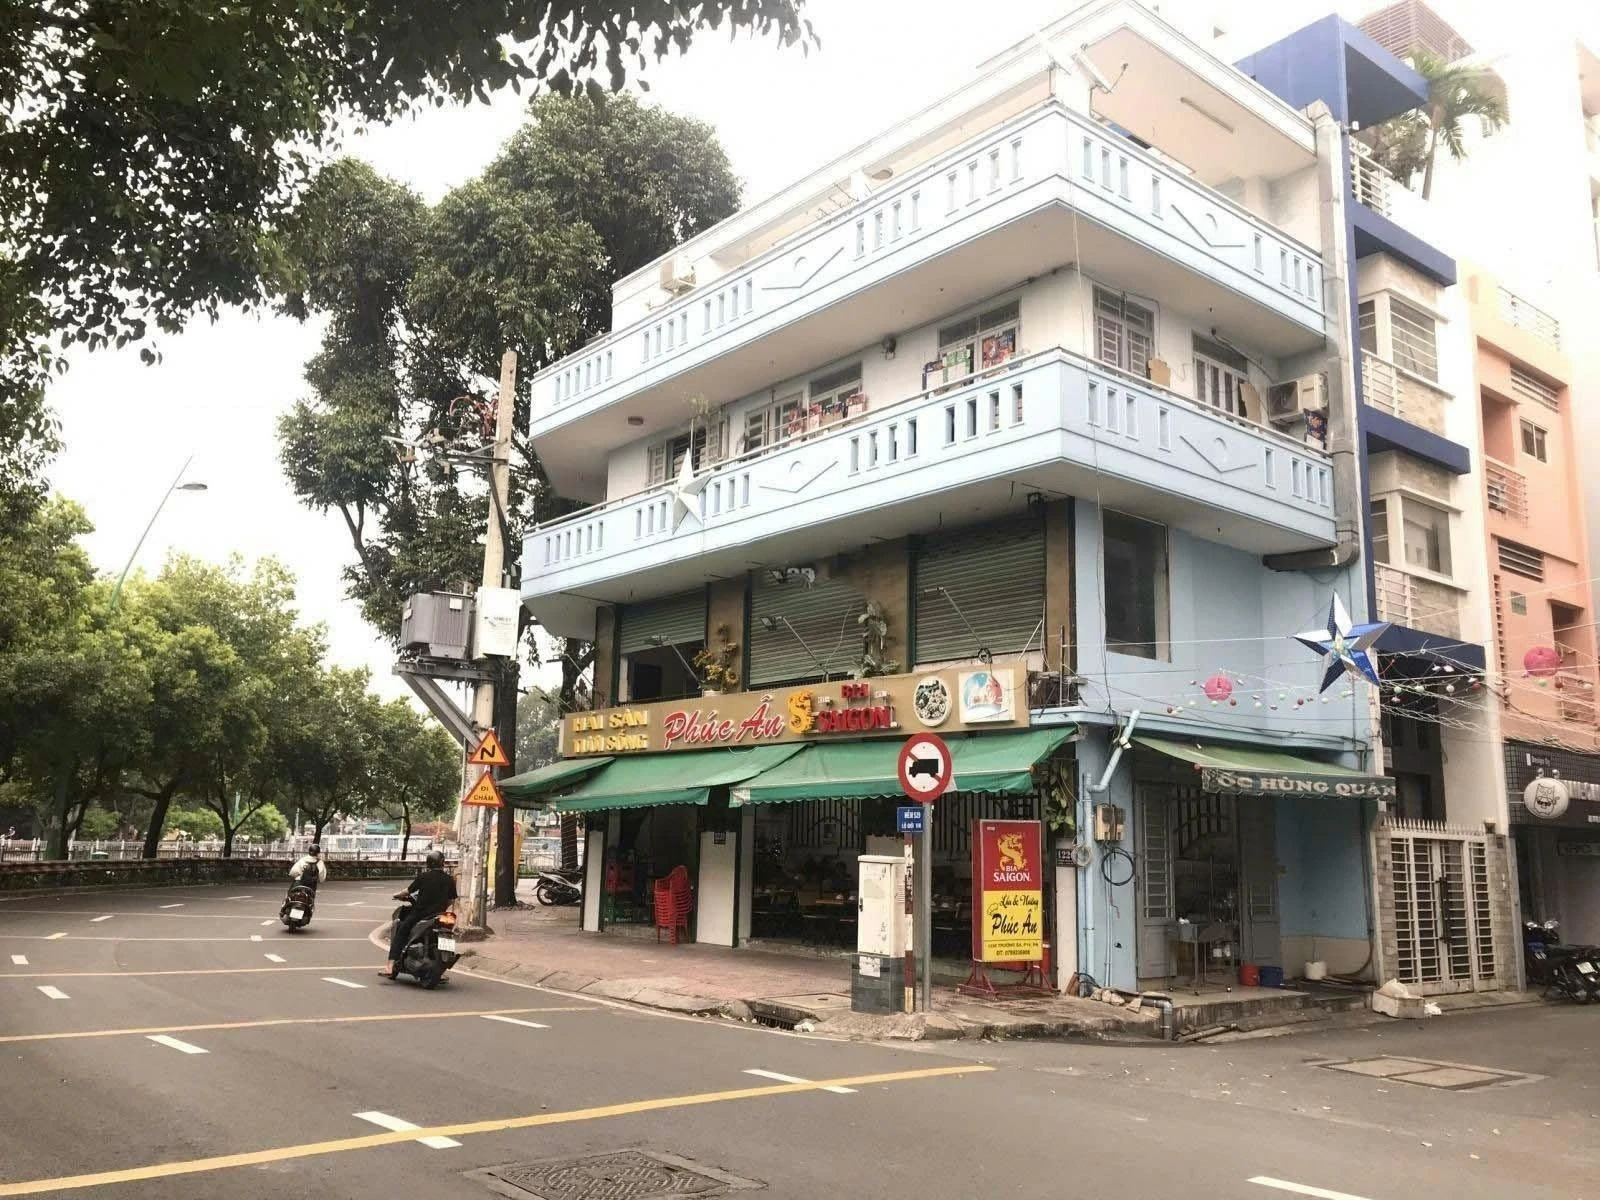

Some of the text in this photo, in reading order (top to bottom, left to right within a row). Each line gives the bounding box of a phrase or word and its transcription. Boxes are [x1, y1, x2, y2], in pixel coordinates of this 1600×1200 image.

[663, 707, 734, 750] Phúc
[818, 705, 891, 732] SAIGON
[1259, 776, 1330, 793] HÙNG
[993, 872, 1031, 882] SAIGON
[991, 908, 1038, 936] Phúc Ân
